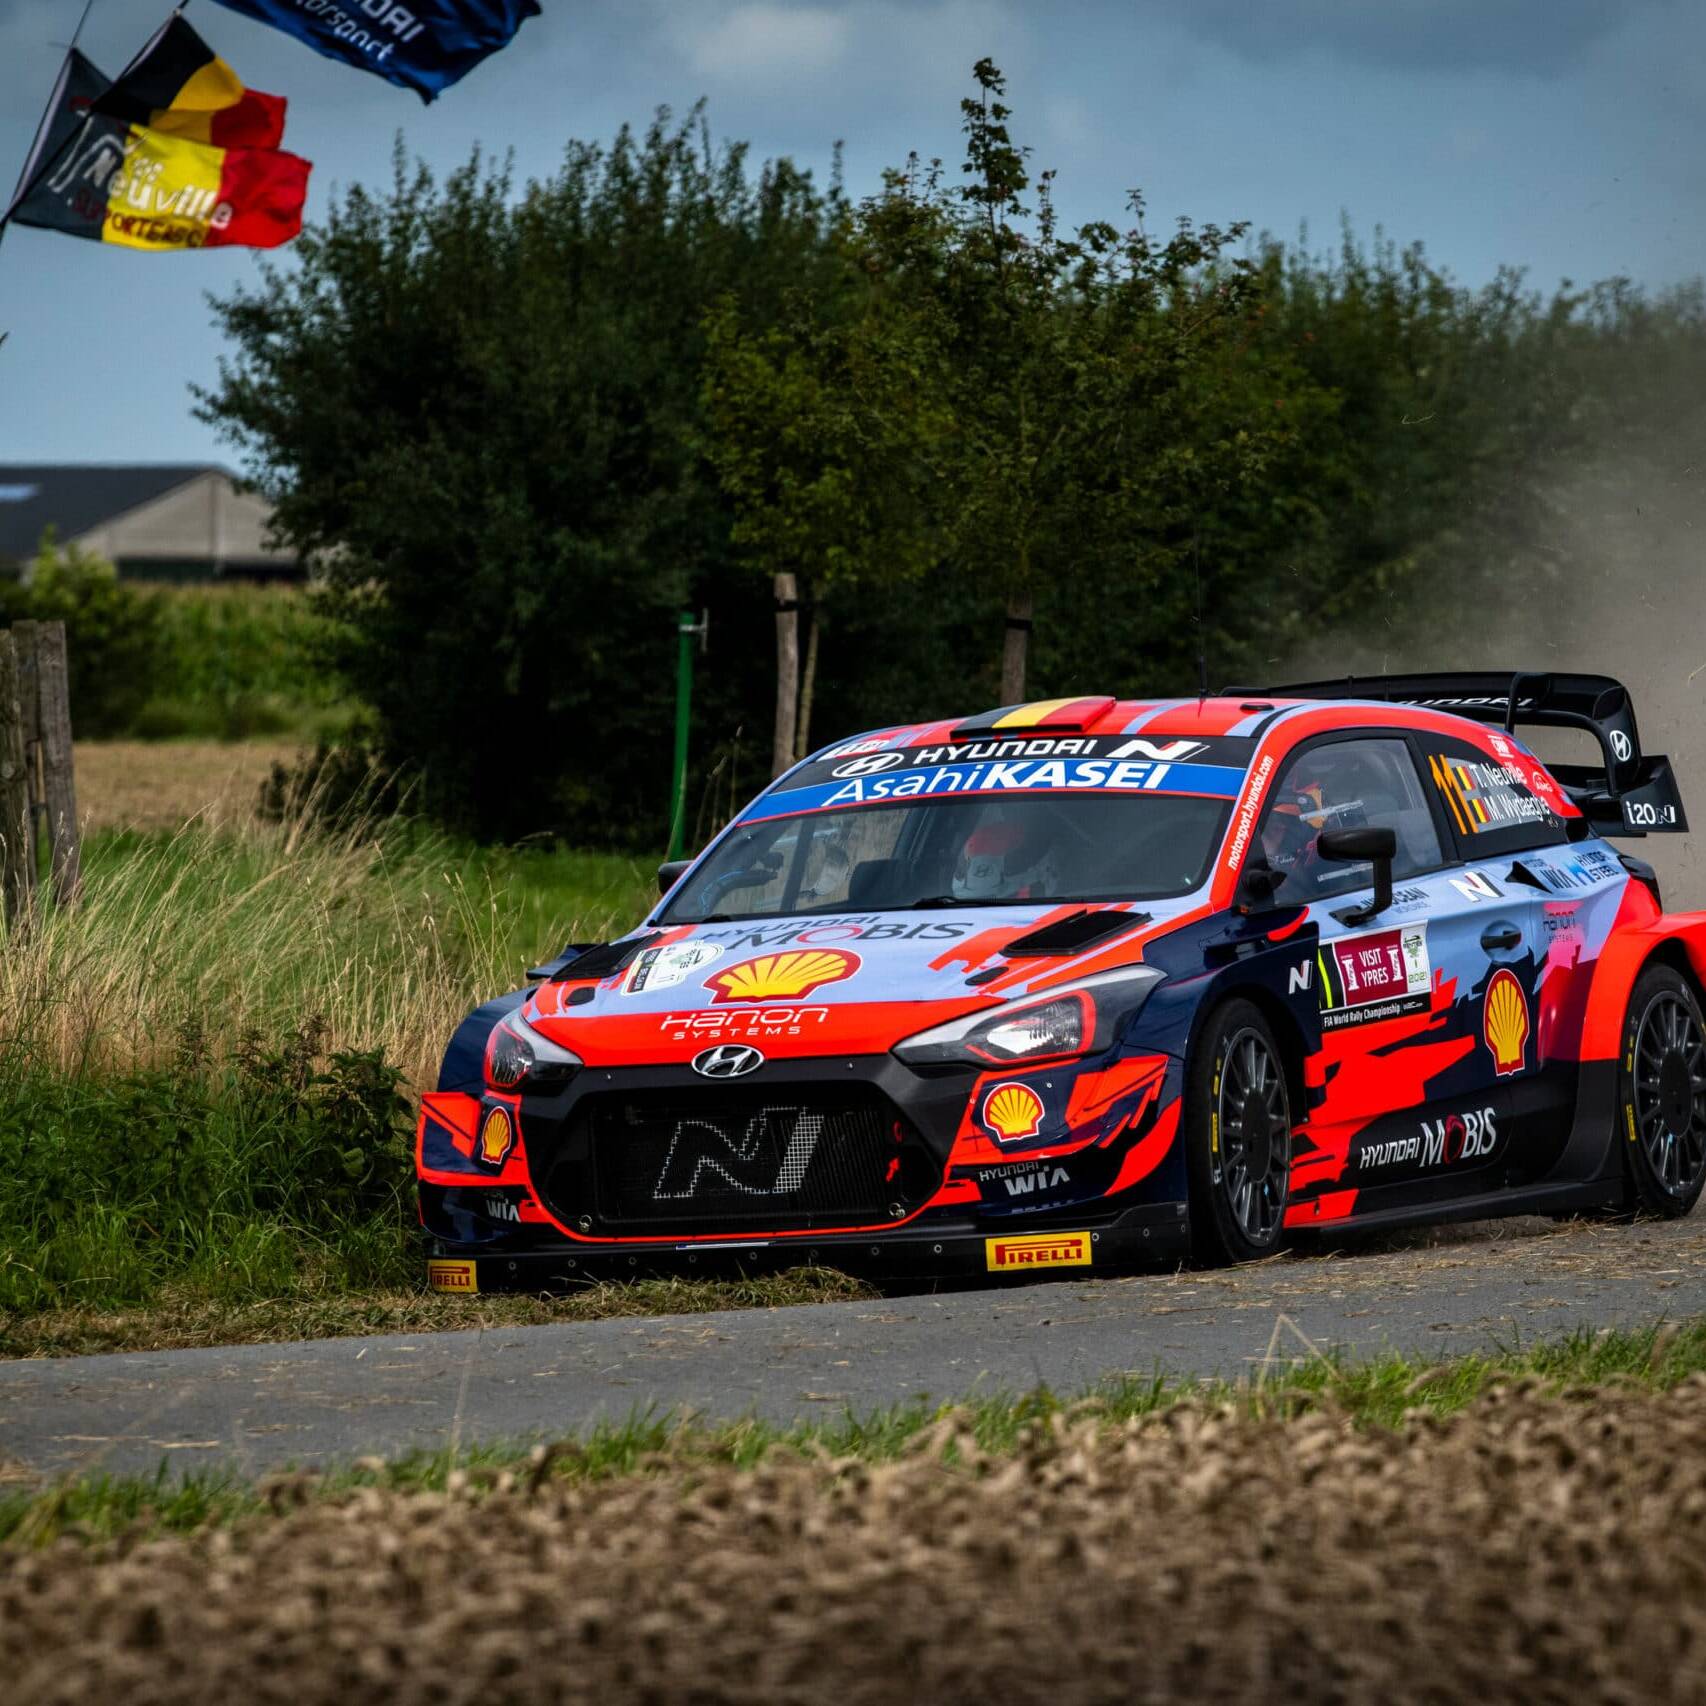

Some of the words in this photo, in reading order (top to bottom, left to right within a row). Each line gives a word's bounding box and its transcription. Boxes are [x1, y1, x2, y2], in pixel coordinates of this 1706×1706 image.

[913, 739, 1098, 765] HYUNDAI
[1469, 764, 1486, 788] T.
[1480, 762, 1528, 787] Neuville
[1228, 755, 1274, 871] motorsport.hyundai.com
[1589, 864, 1620, 882] STEEL
[700, 916, 882, 940] HYUNDAI
[724, 922, 974, 950] MOBIS
[1358, 947, 1382, 967] VISIT
[1360, 967, 1390, 988] YPRES
[1323, 1016, 1334, 1028] FIA
[1334, 1013, 1349, 1026] World
[1349, 1010, 1363, 1023] Rally
[1363, 1003, 1401, 1019] Championship
[672, 1026, 803, 1040] SYSTEMS
[1360, 1137, 1421, 1169] HYUNDAI
[1419, 1107, 1497, 1168] MOBIS
[979, 1161, 1040, 1182] HYUNDAI
[1004, 1166, 1070, 1196] WIA
[486, 1198, 522, 1223] WIA
[995, 1239, 1083, 1265] PIRELLI
